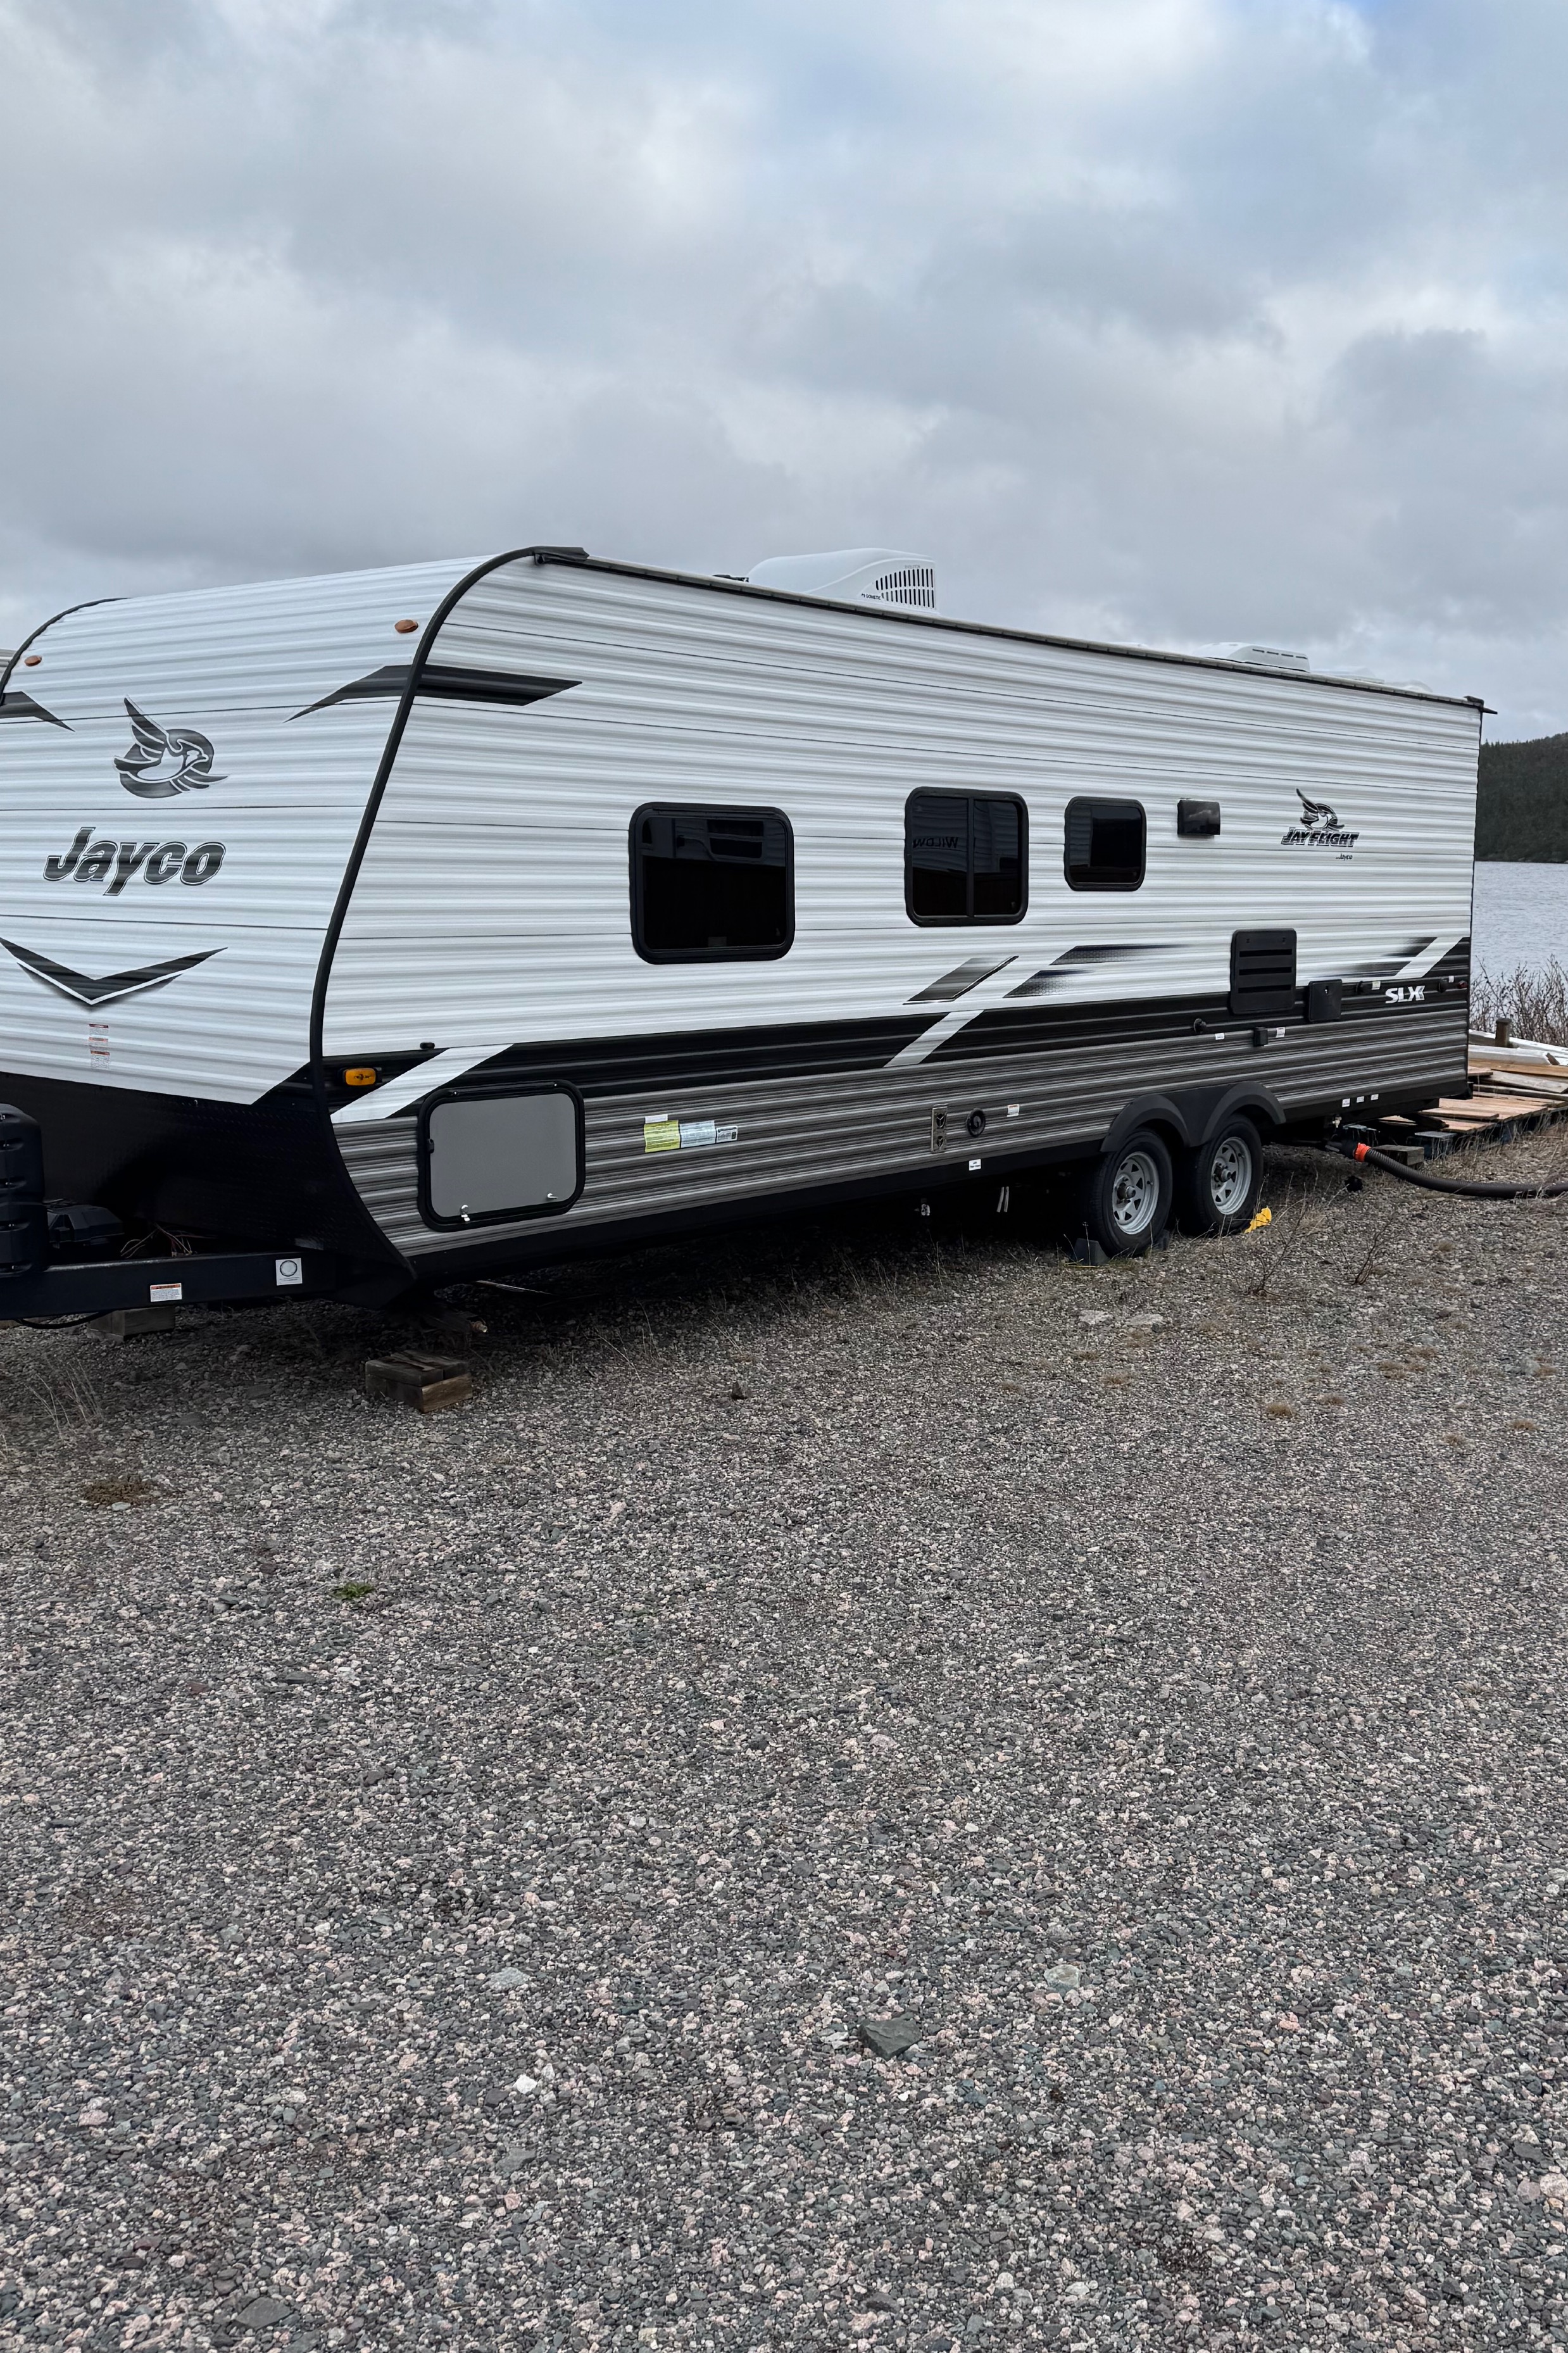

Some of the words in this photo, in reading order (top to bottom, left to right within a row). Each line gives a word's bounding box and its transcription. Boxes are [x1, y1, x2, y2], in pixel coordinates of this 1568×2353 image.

[1281, 827, 1309, 846] JAY
[1308, 829, 1360, 848] FLIGHT
[43, 827, 226, 896] Jayco
[1385, 986, 1425, 1003] SLX
